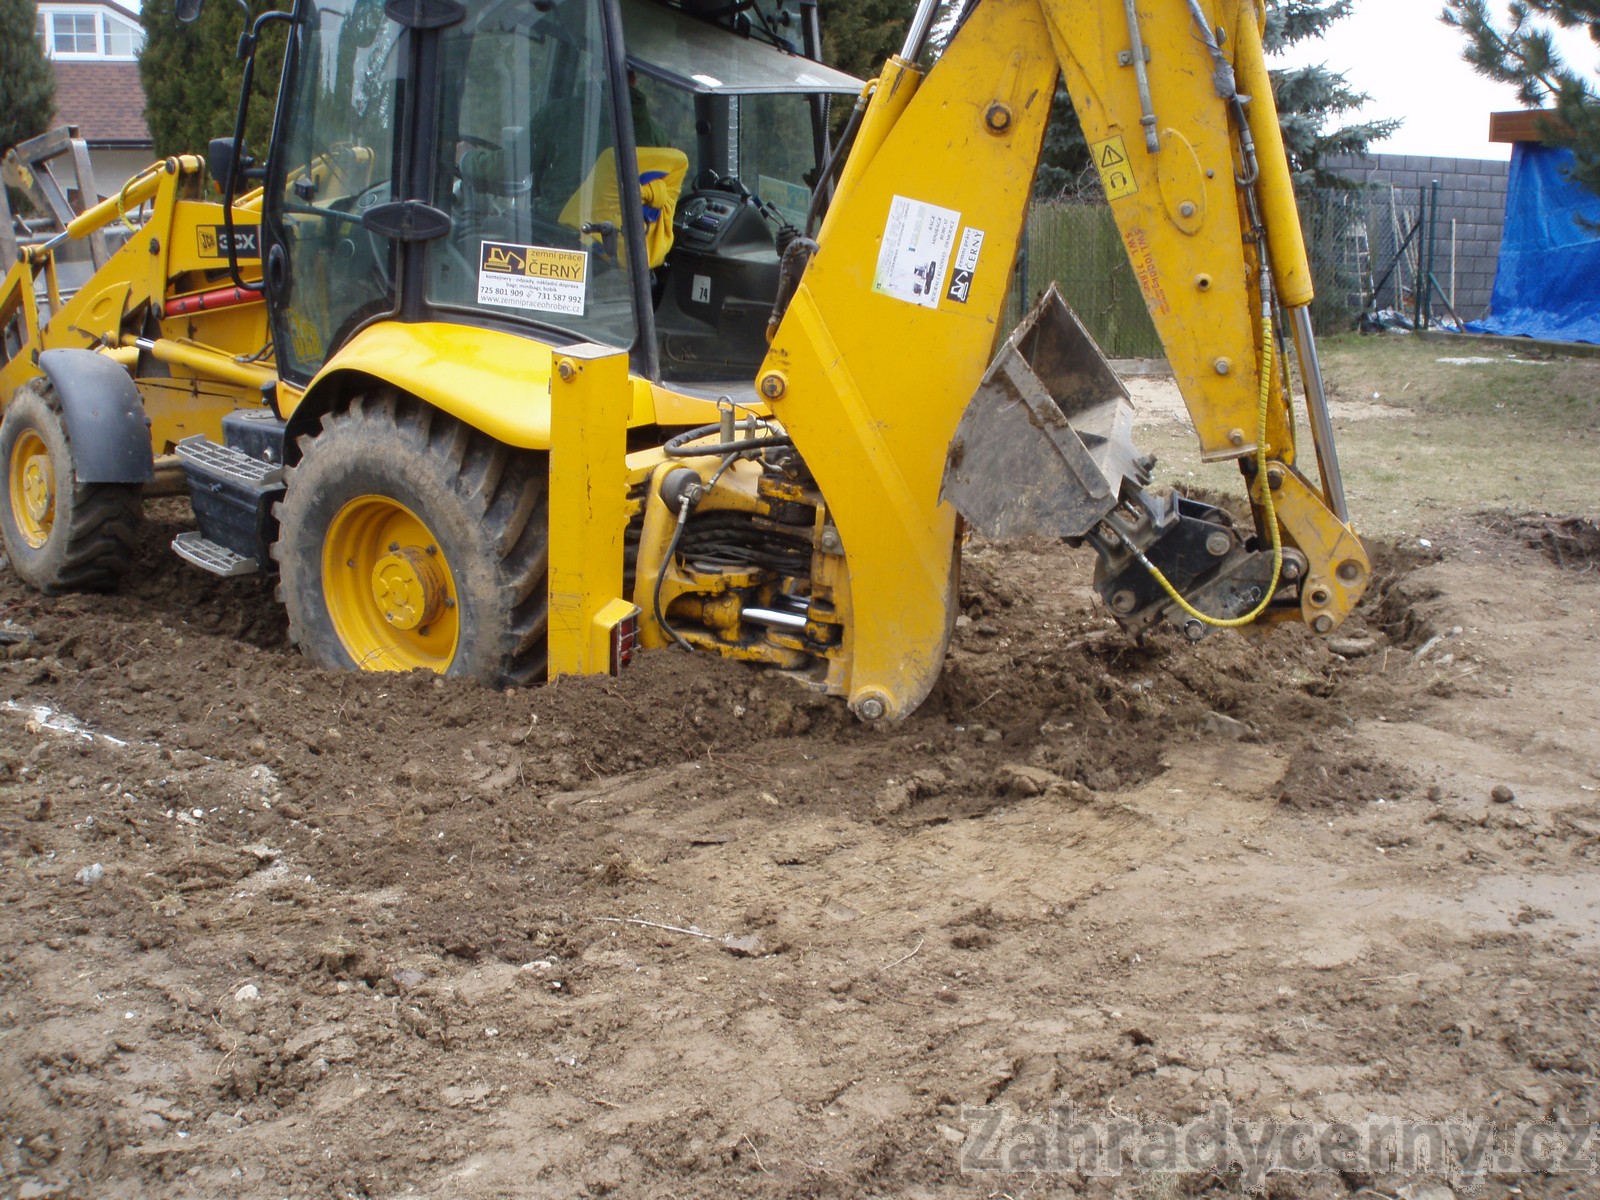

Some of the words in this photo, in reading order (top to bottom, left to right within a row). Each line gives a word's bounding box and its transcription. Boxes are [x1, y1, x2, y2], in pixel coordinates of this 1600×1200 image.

[965, 230, 982, 270] ČERNÝ
[1125, 232, 1138, 256] SWL
[531, 250, 556, 259] zemní
[558, 252, 582, 262] práce
[959, 246, 967, 267] zemní
[529, 259, 580, 279] ČERNÝ
[486, 274, 511, 282] kontejnery
[559, 282, 579, 290] doprava
[480, 286, 493, 294] 725
[537, 292, 550, 300] 731
[700, 288, 708, 300] 74
[481, 295, 580, 312] www.zemnipraceohrobec.cz
